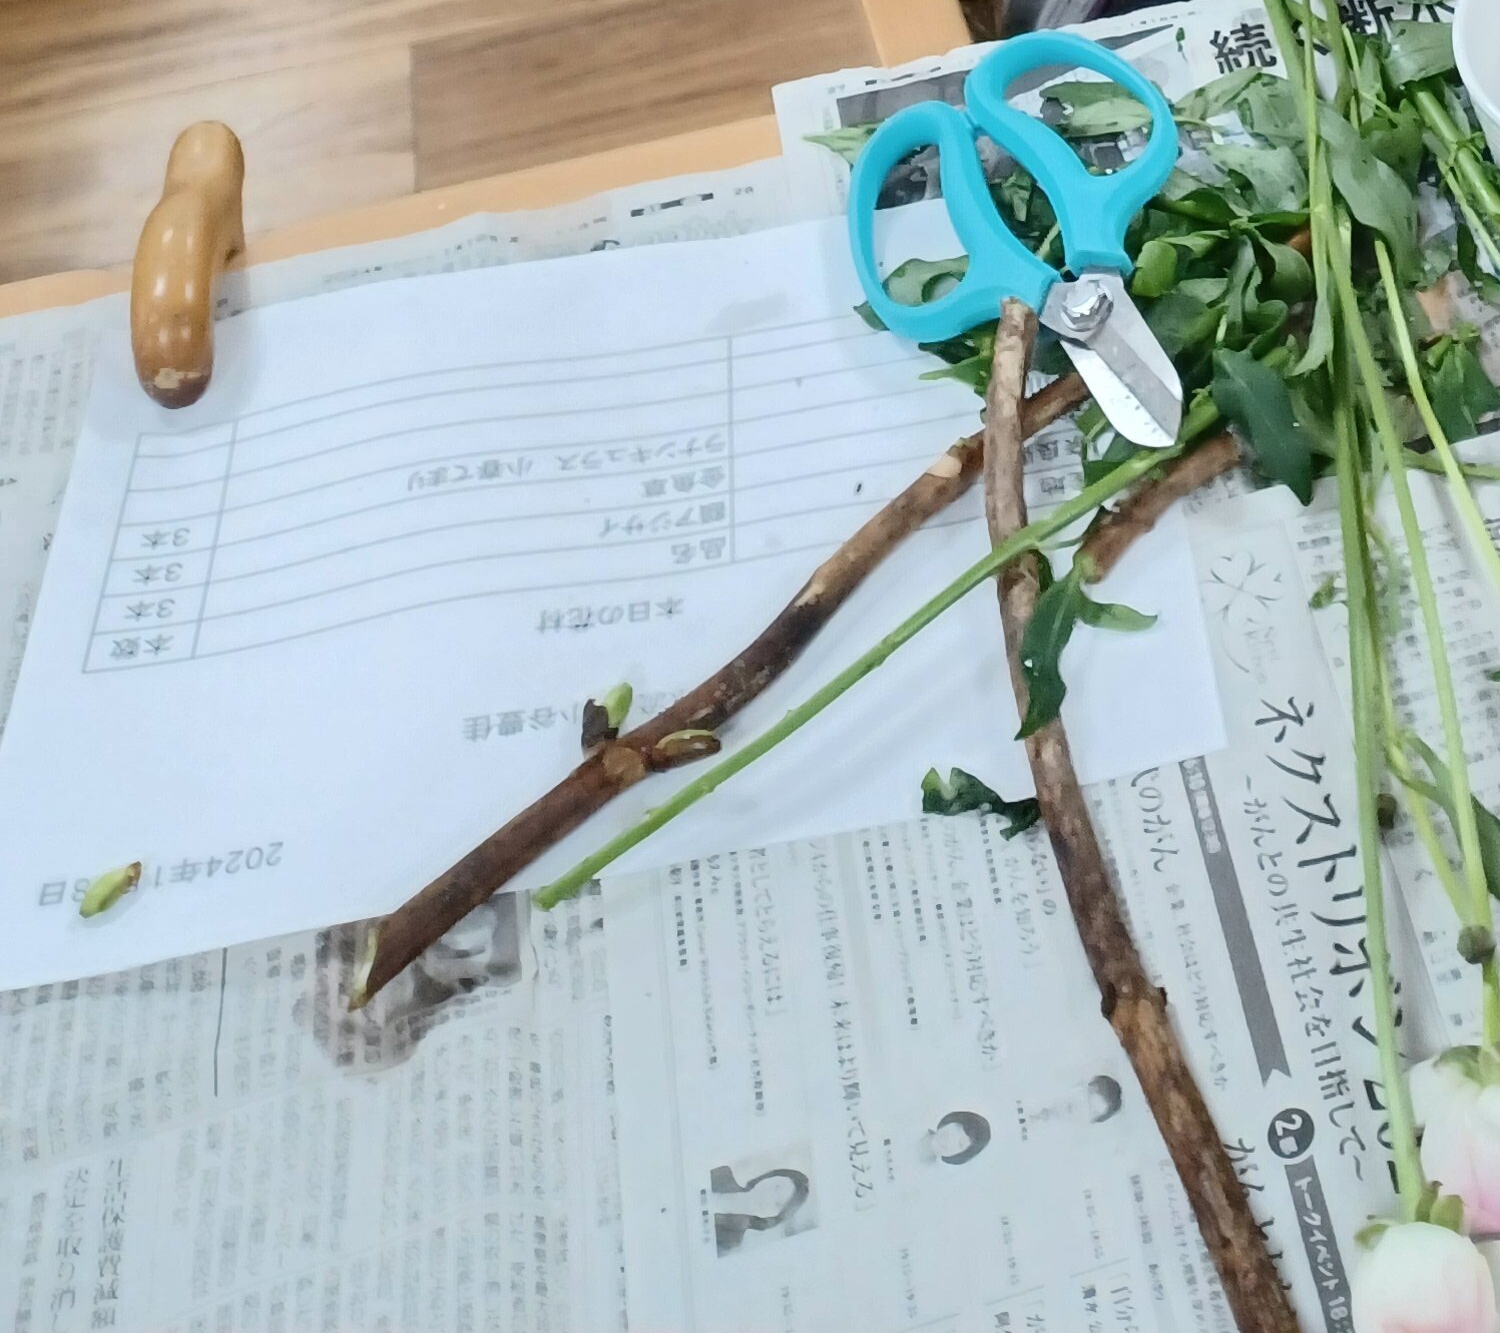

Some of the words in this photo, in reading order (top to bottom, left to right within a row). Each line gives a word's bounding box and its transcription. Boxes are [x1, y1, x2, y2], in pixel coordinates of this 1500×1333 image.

[555, 434, 724, 469] ラナンキュラス
[643, 466, 724, 497] 金魚草
[140, 521, 193, 555] 3本
[671, 537, 725, 564] 品名
[132, 557, 185, 589] 3本
[124, 594, 177, 626] 3本
[538, 598, 683, 634] 本日の花材
[110, 627, 174, 667] 本数
[1288, 1172, 1344, 1293] トークイベント
